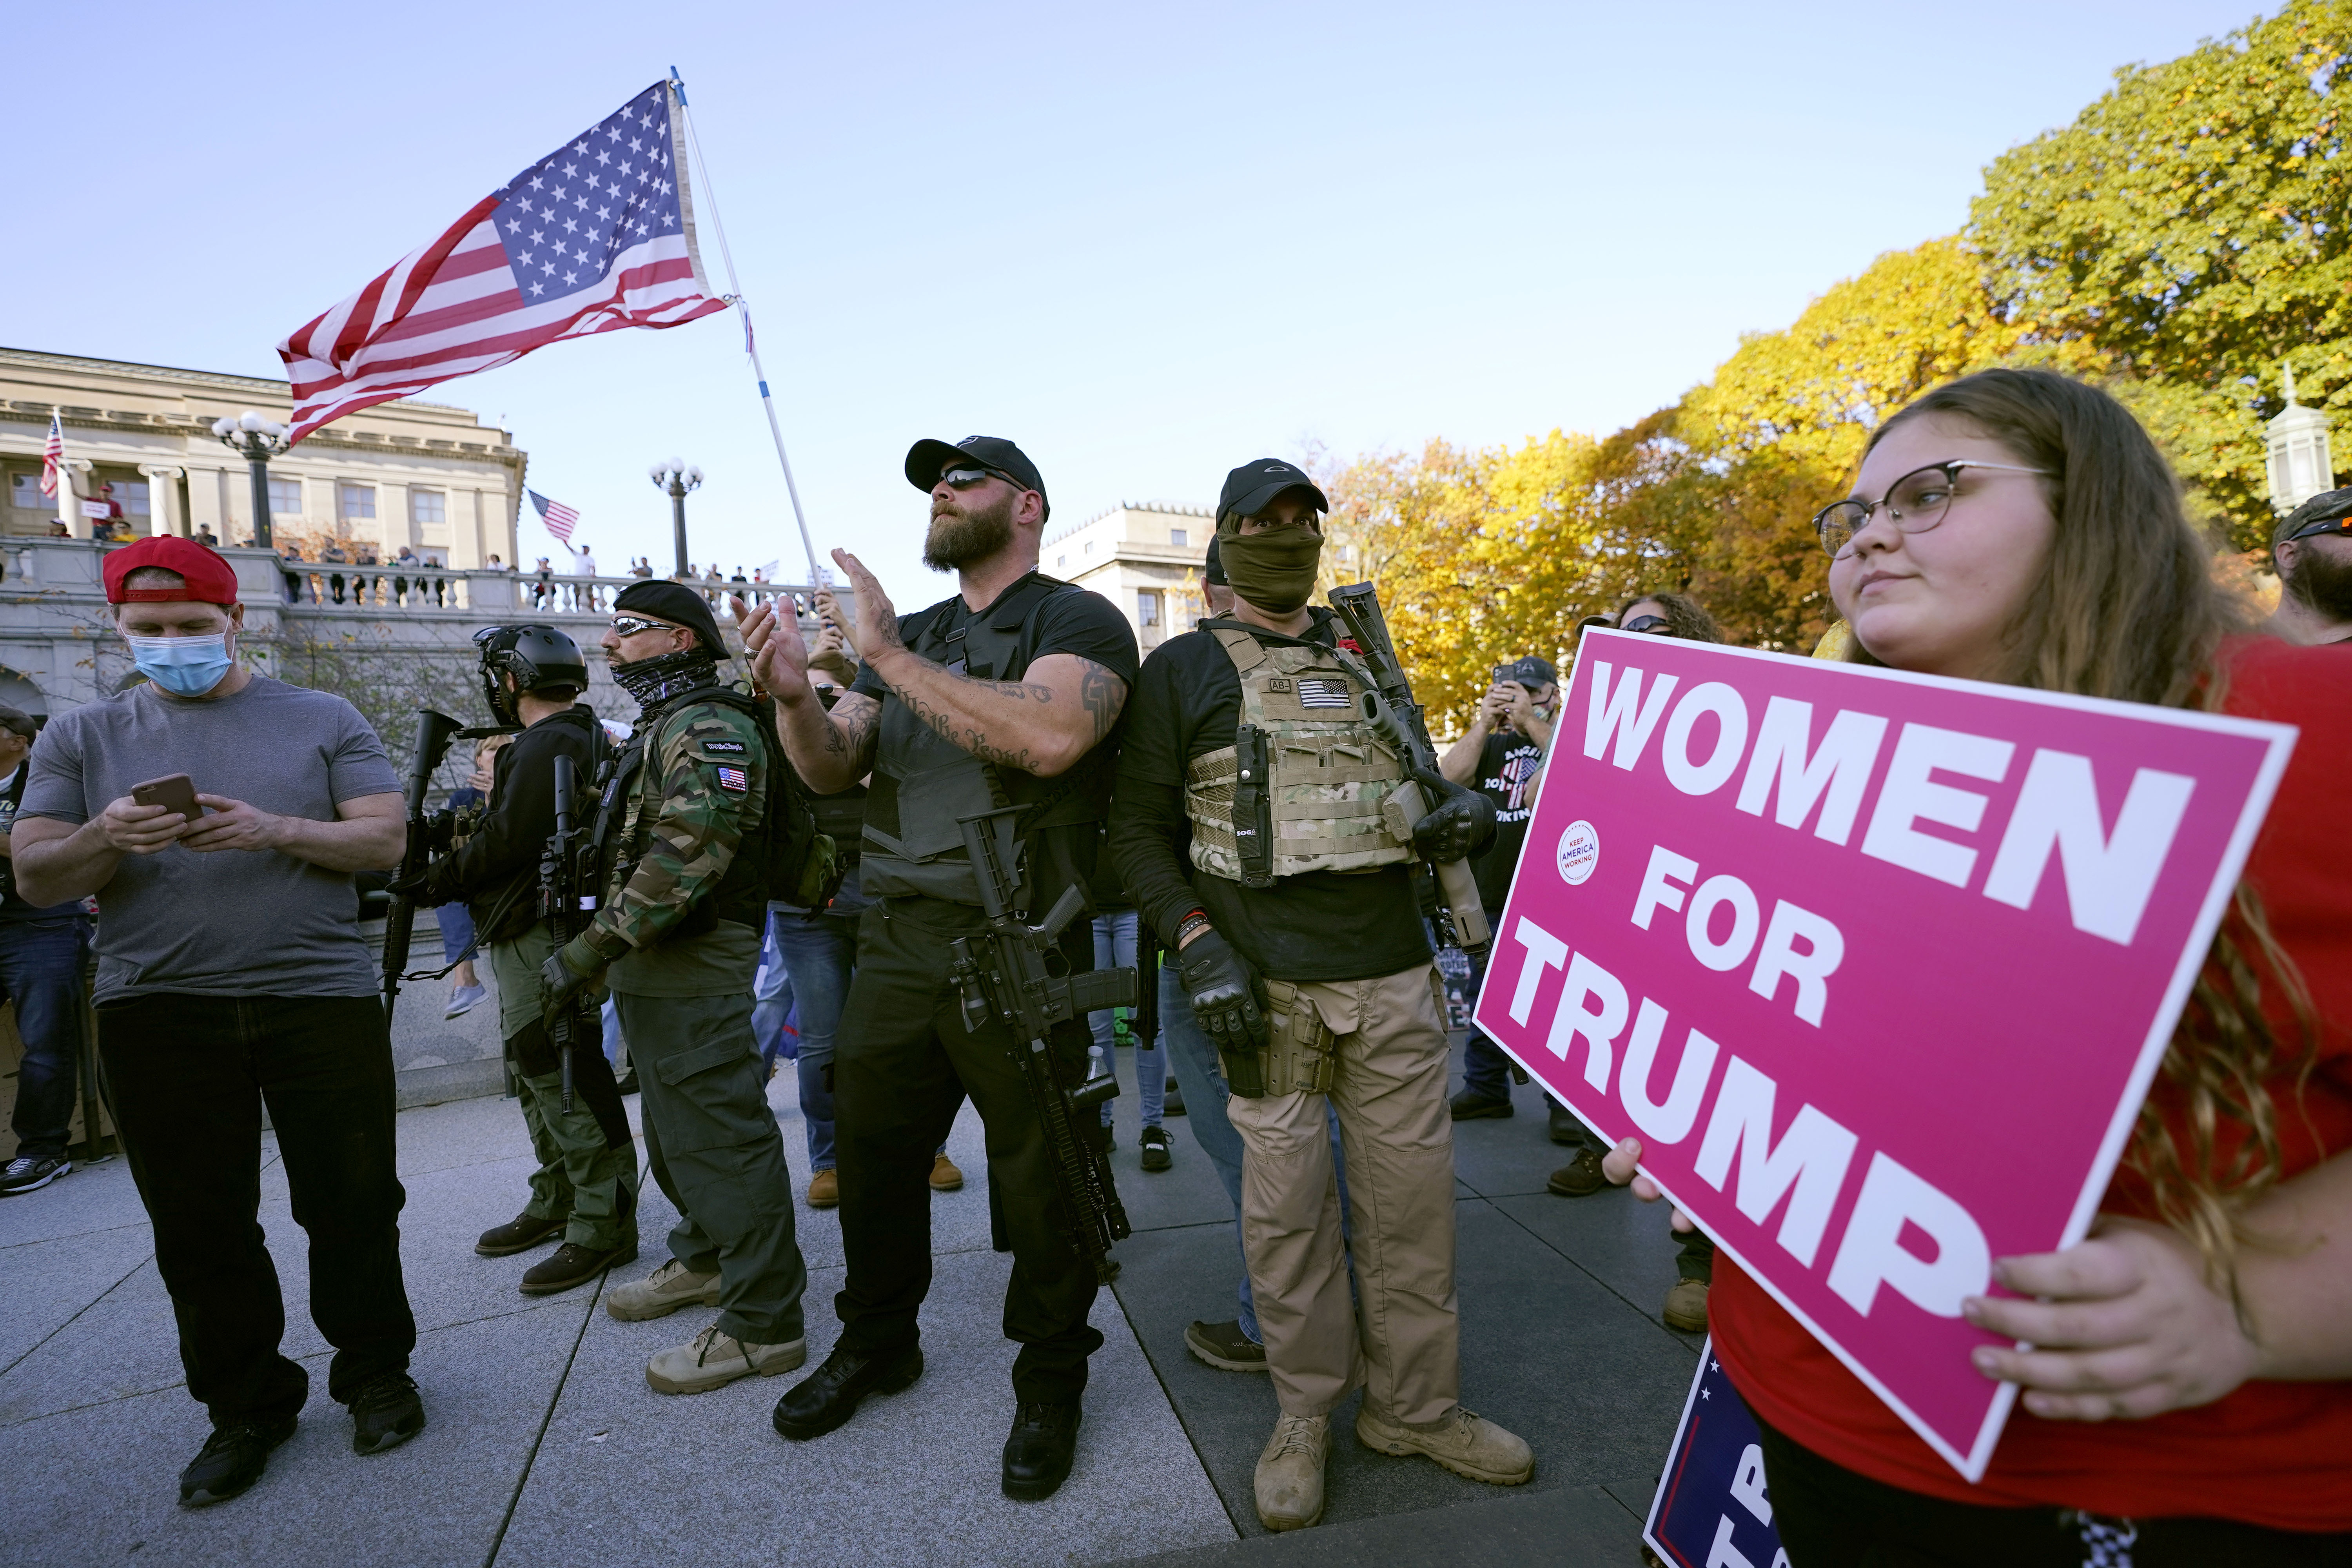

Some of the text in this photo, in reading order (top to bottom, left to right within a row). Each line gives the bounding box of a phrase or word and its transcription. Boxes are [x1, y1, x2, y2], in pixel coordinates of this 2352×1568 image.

[1562, 843, 1593, 861] AMERICA
[1570, 837, 1584, 848] KEEP
[1583, 660, 2196, 945] WOMEN
[1564, 854, 1592, 869] WORKING
[1631, 845, 1844, 1027] FOR
[1509, 915, 1991, 1316] TRUMP
